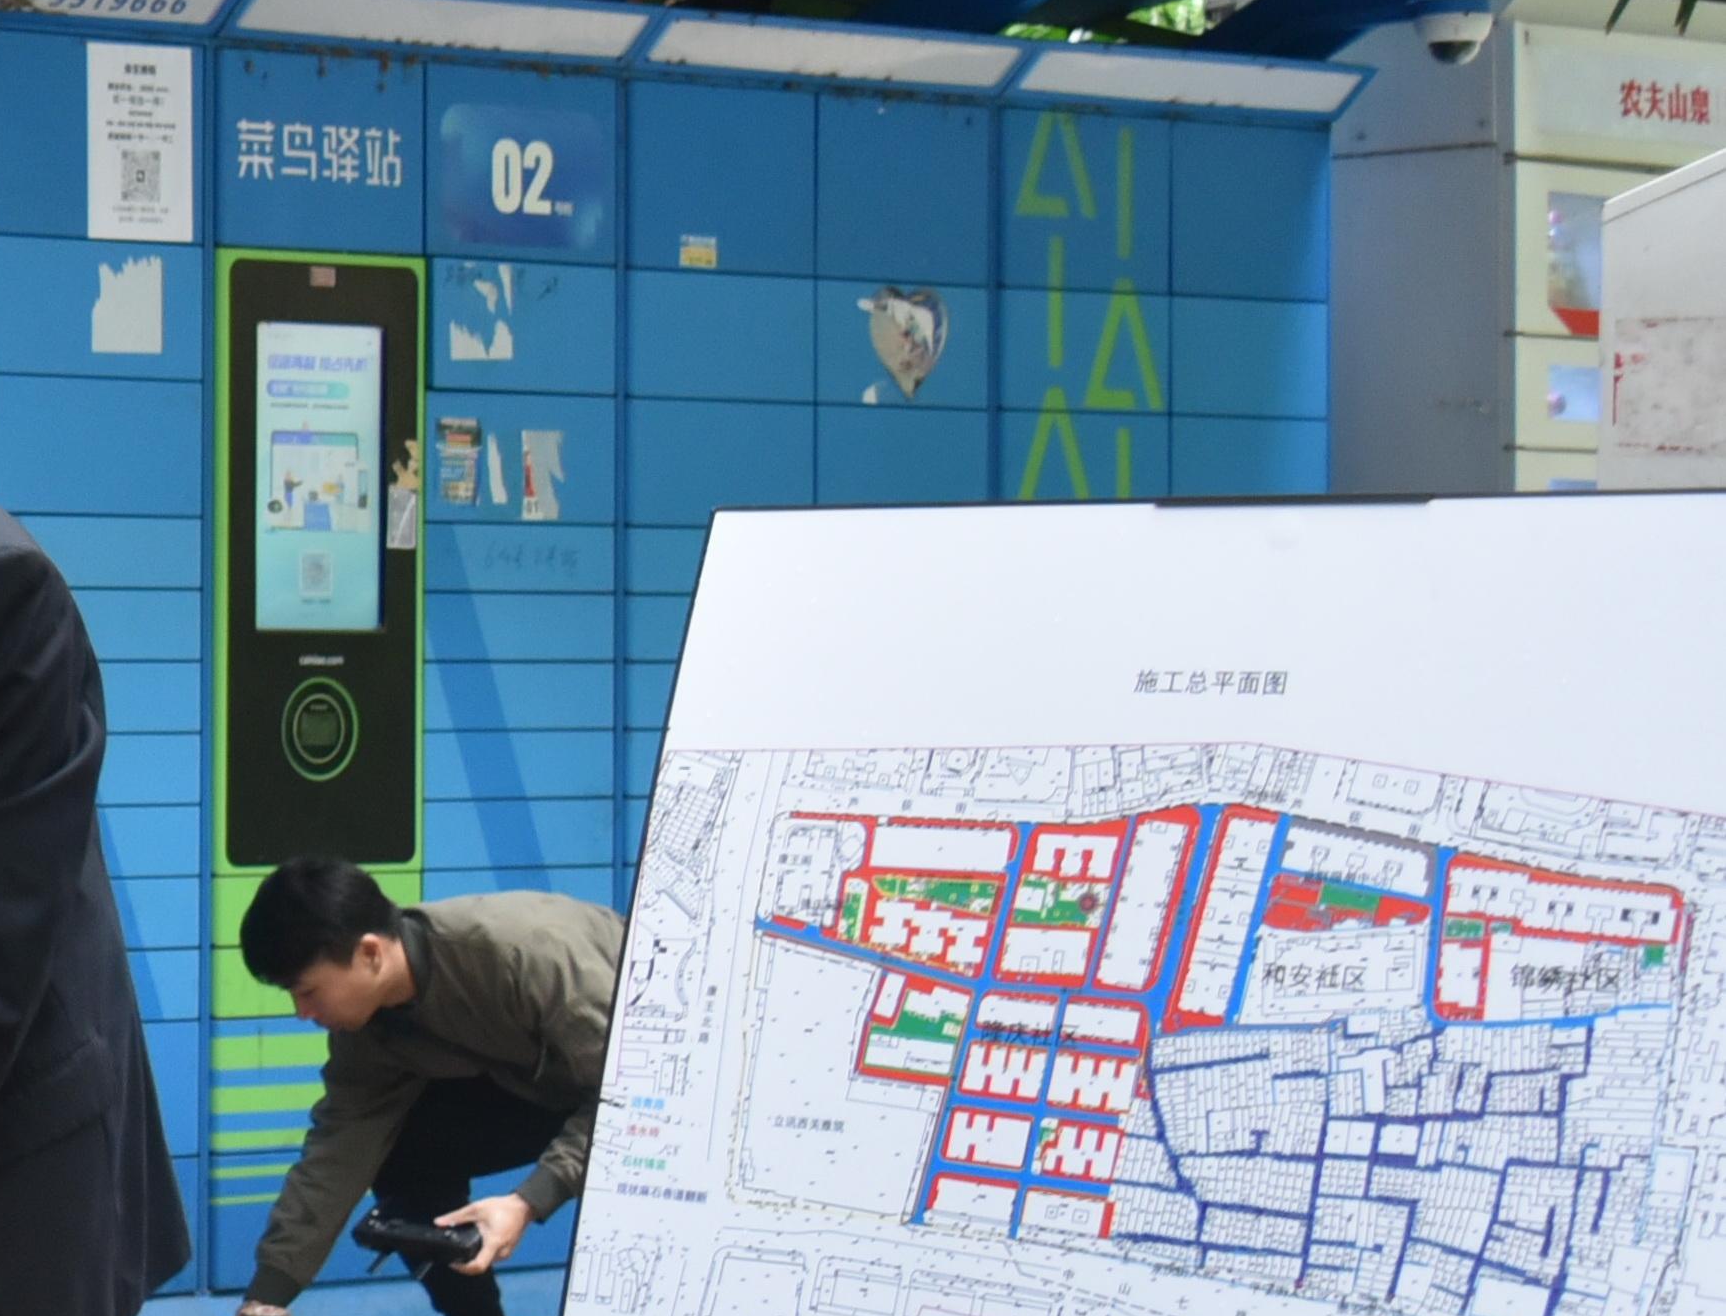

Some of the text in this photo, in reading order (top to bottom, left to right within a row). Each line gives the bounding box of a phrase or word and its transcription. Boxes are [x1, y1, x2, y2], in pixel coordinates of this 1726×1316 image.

[1620, 78, 1711, 125] 农夫山泉
[236, 117, 403, 187] 菜鸟驿站
[491, 137, 553, 216] 02
[1133, 669, 1289, 696] 施工总平面图
[1262, 961, 1369, 991] 和安社区
